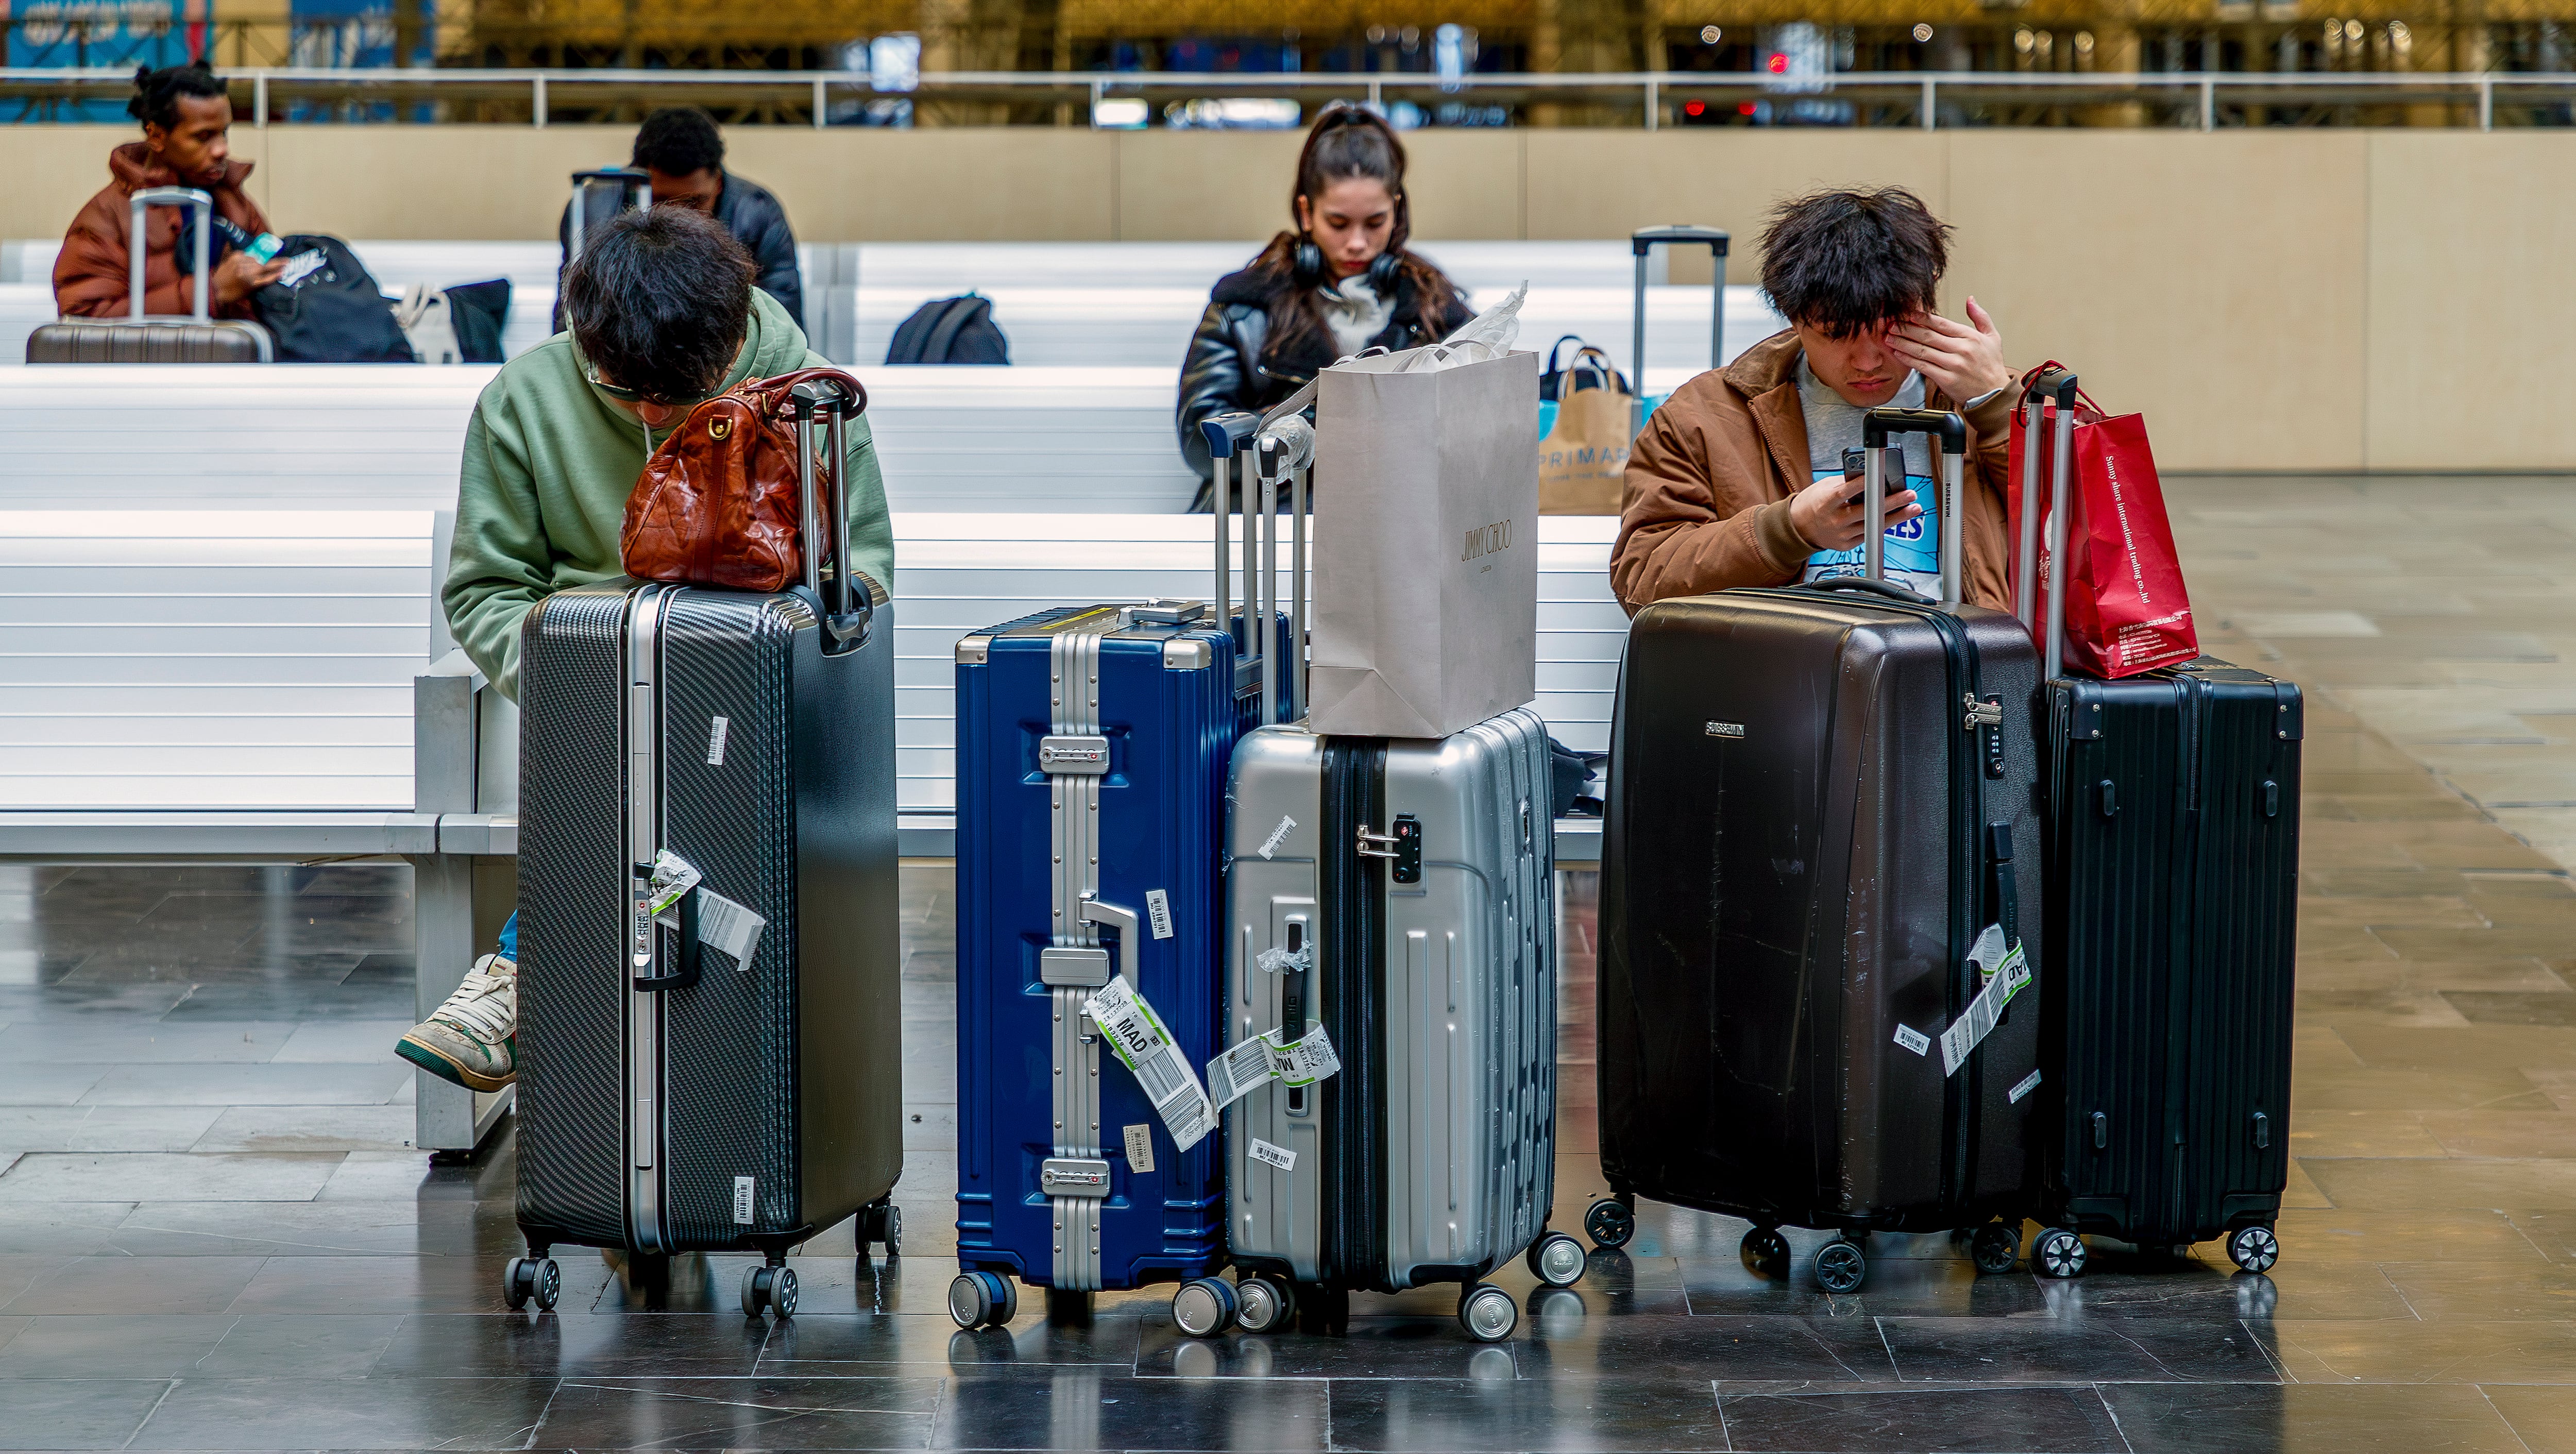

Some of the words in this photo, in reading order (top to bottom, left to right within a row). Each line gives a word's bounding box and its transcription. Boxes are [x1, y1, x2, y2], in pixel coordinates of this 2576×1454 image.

[1884, 516, 1923, 539] ES
[2105, 455, 2117, 480] Sunny
[2111, 481, 2121, 502] share
[2117, 502, 2137, 551] international
[2129, 551, 2142, 580] trading
[1462, 527, 1486, 562] JIMMY
[1486, 519, 1512, 554] CHOO
[1116, 1017, 1148, 1053] MAD
